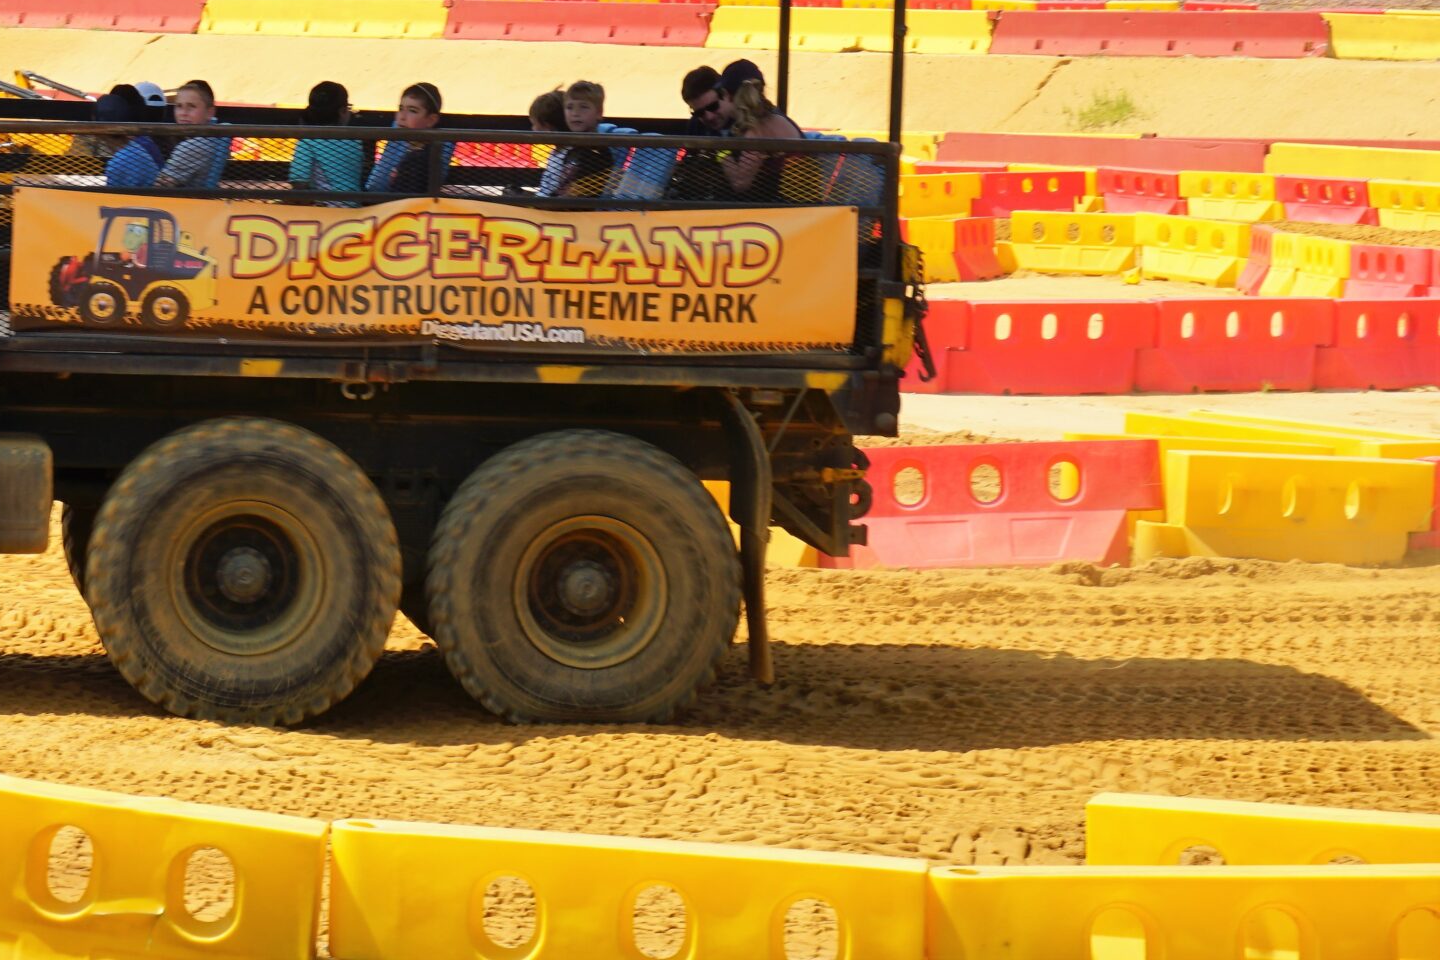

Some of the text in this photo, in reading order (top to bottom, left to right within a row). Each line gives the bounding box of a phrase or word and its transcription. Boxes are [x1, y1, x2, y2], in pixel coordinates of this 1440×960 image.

[227, 212, 783, 288] DIGGERLAND
[246, 284, 758, 324] A CONSTRUCTION THEME PARK
[421, 320, 585, 344] DiggerlandUSA.com
